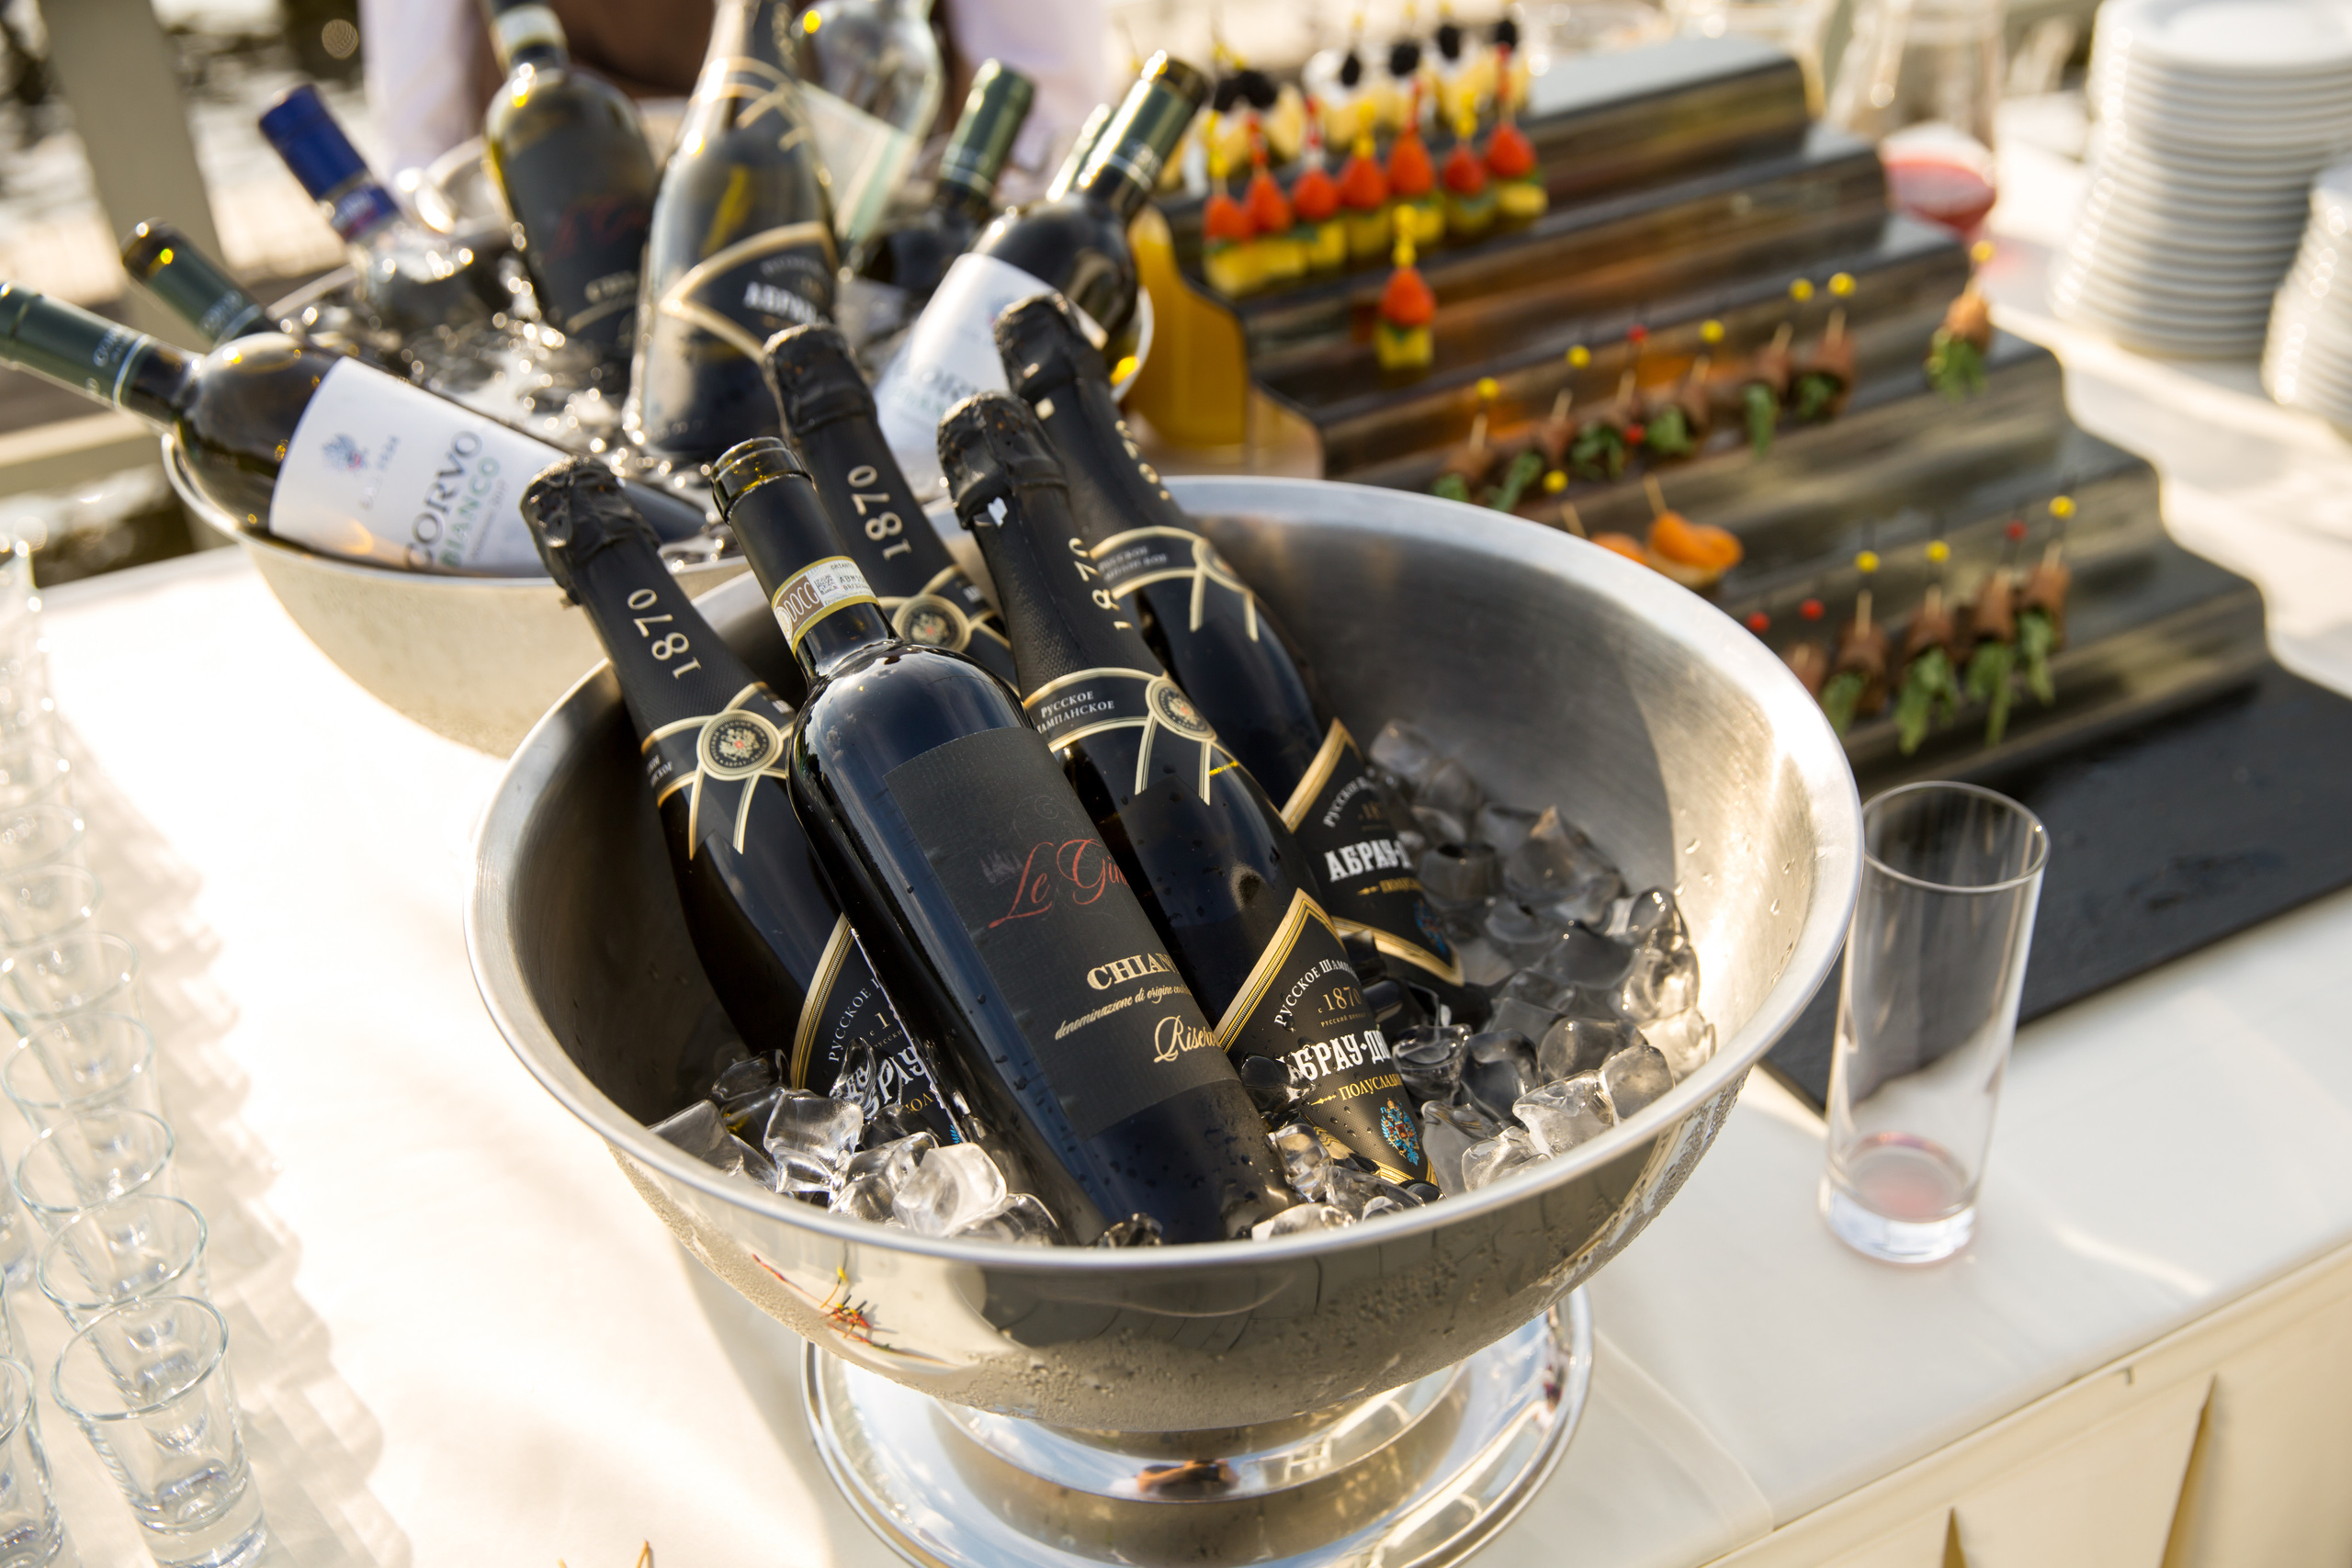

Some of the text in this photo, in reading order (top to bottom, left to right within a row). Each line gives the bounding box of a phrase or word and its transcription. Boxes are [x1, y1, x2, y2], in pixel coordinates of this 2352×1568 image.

[847, 465, 912, 560] 1870
[628, 589, 702, 680] 1870
[1041, 691, 1095, 718] РУССКОЕ
[989, 841, 1055, 930] Le
[1087, 953, 1180, 991] CHIAN
[1274, 966, 1320, 1027] РУССКОЕ
[1323, 986, 1362, 1011] 1870
[829, 987, 872, 1062] РУССКОЕ
[1055, 997, 1134, 1041] denominazione
[1135, 987, 1146, 1003] di
[1147, 984, 1174, 1004] origine
